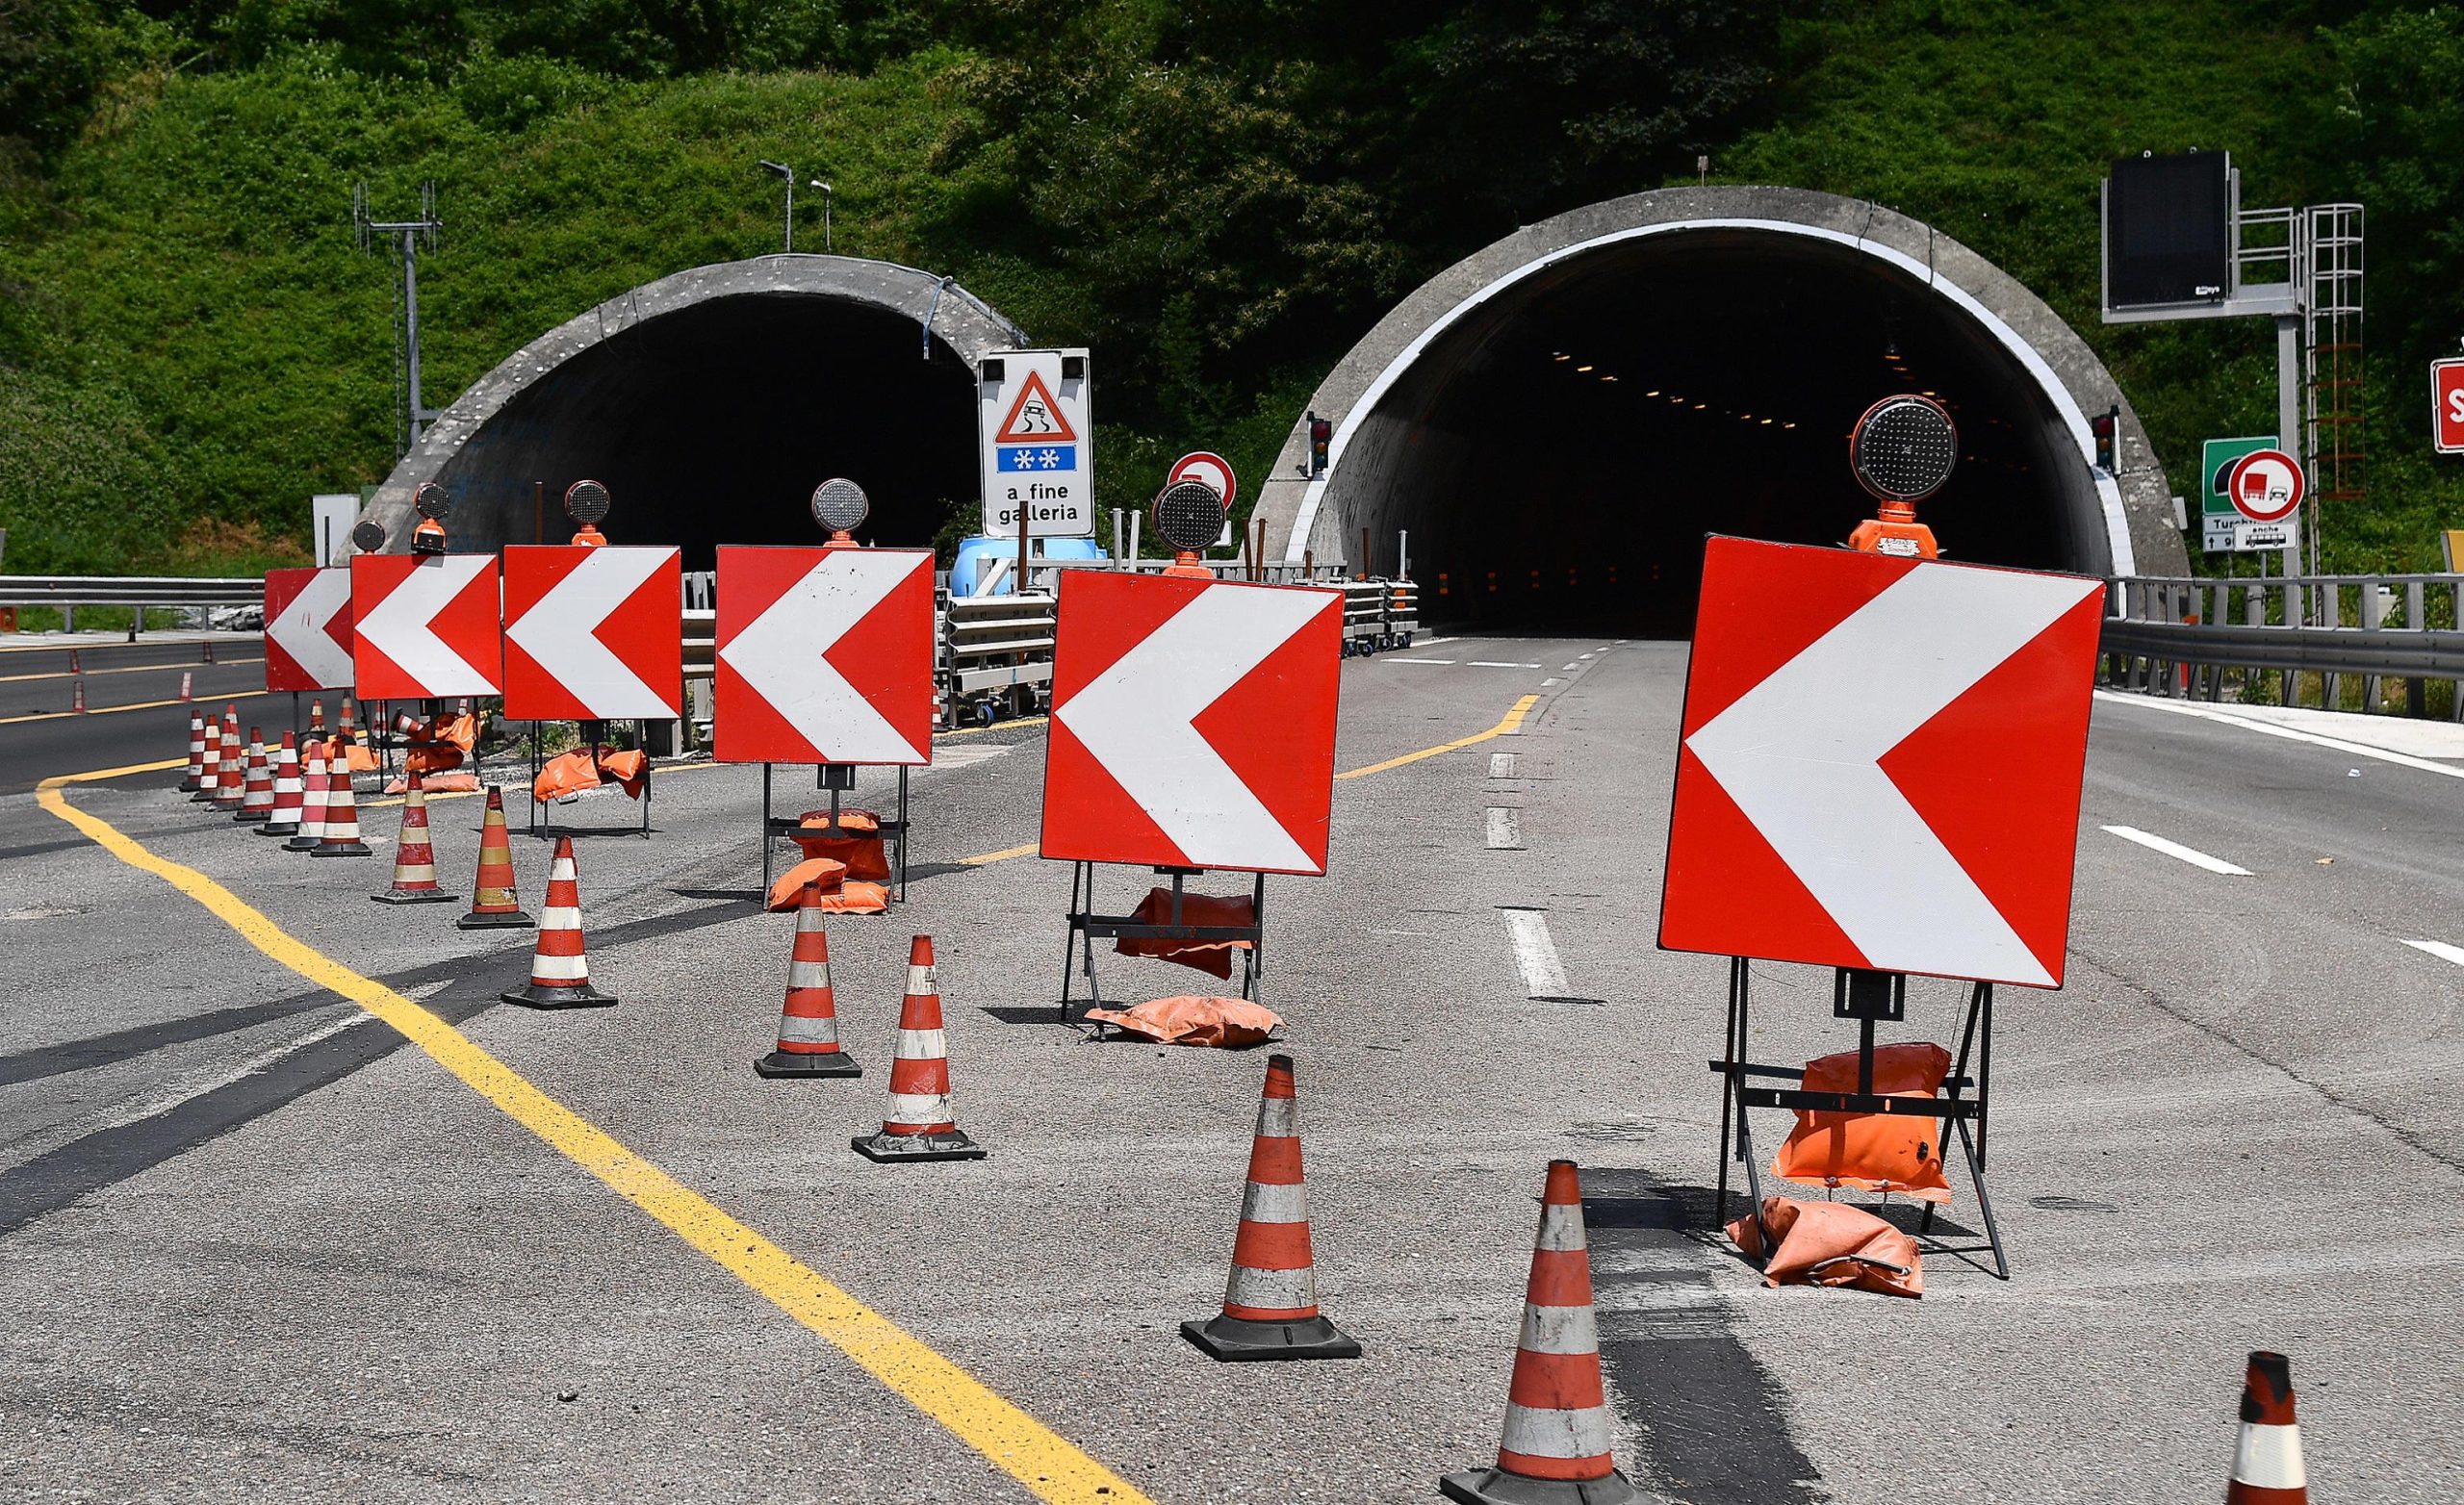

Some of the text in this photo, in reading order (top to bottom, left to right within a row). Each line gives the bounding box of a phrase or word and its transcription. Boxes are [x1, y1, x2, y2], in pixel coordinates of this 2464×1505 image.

[1007, 483, 1068, 500] a fine
[999, 504, 1078, 524] galeria
